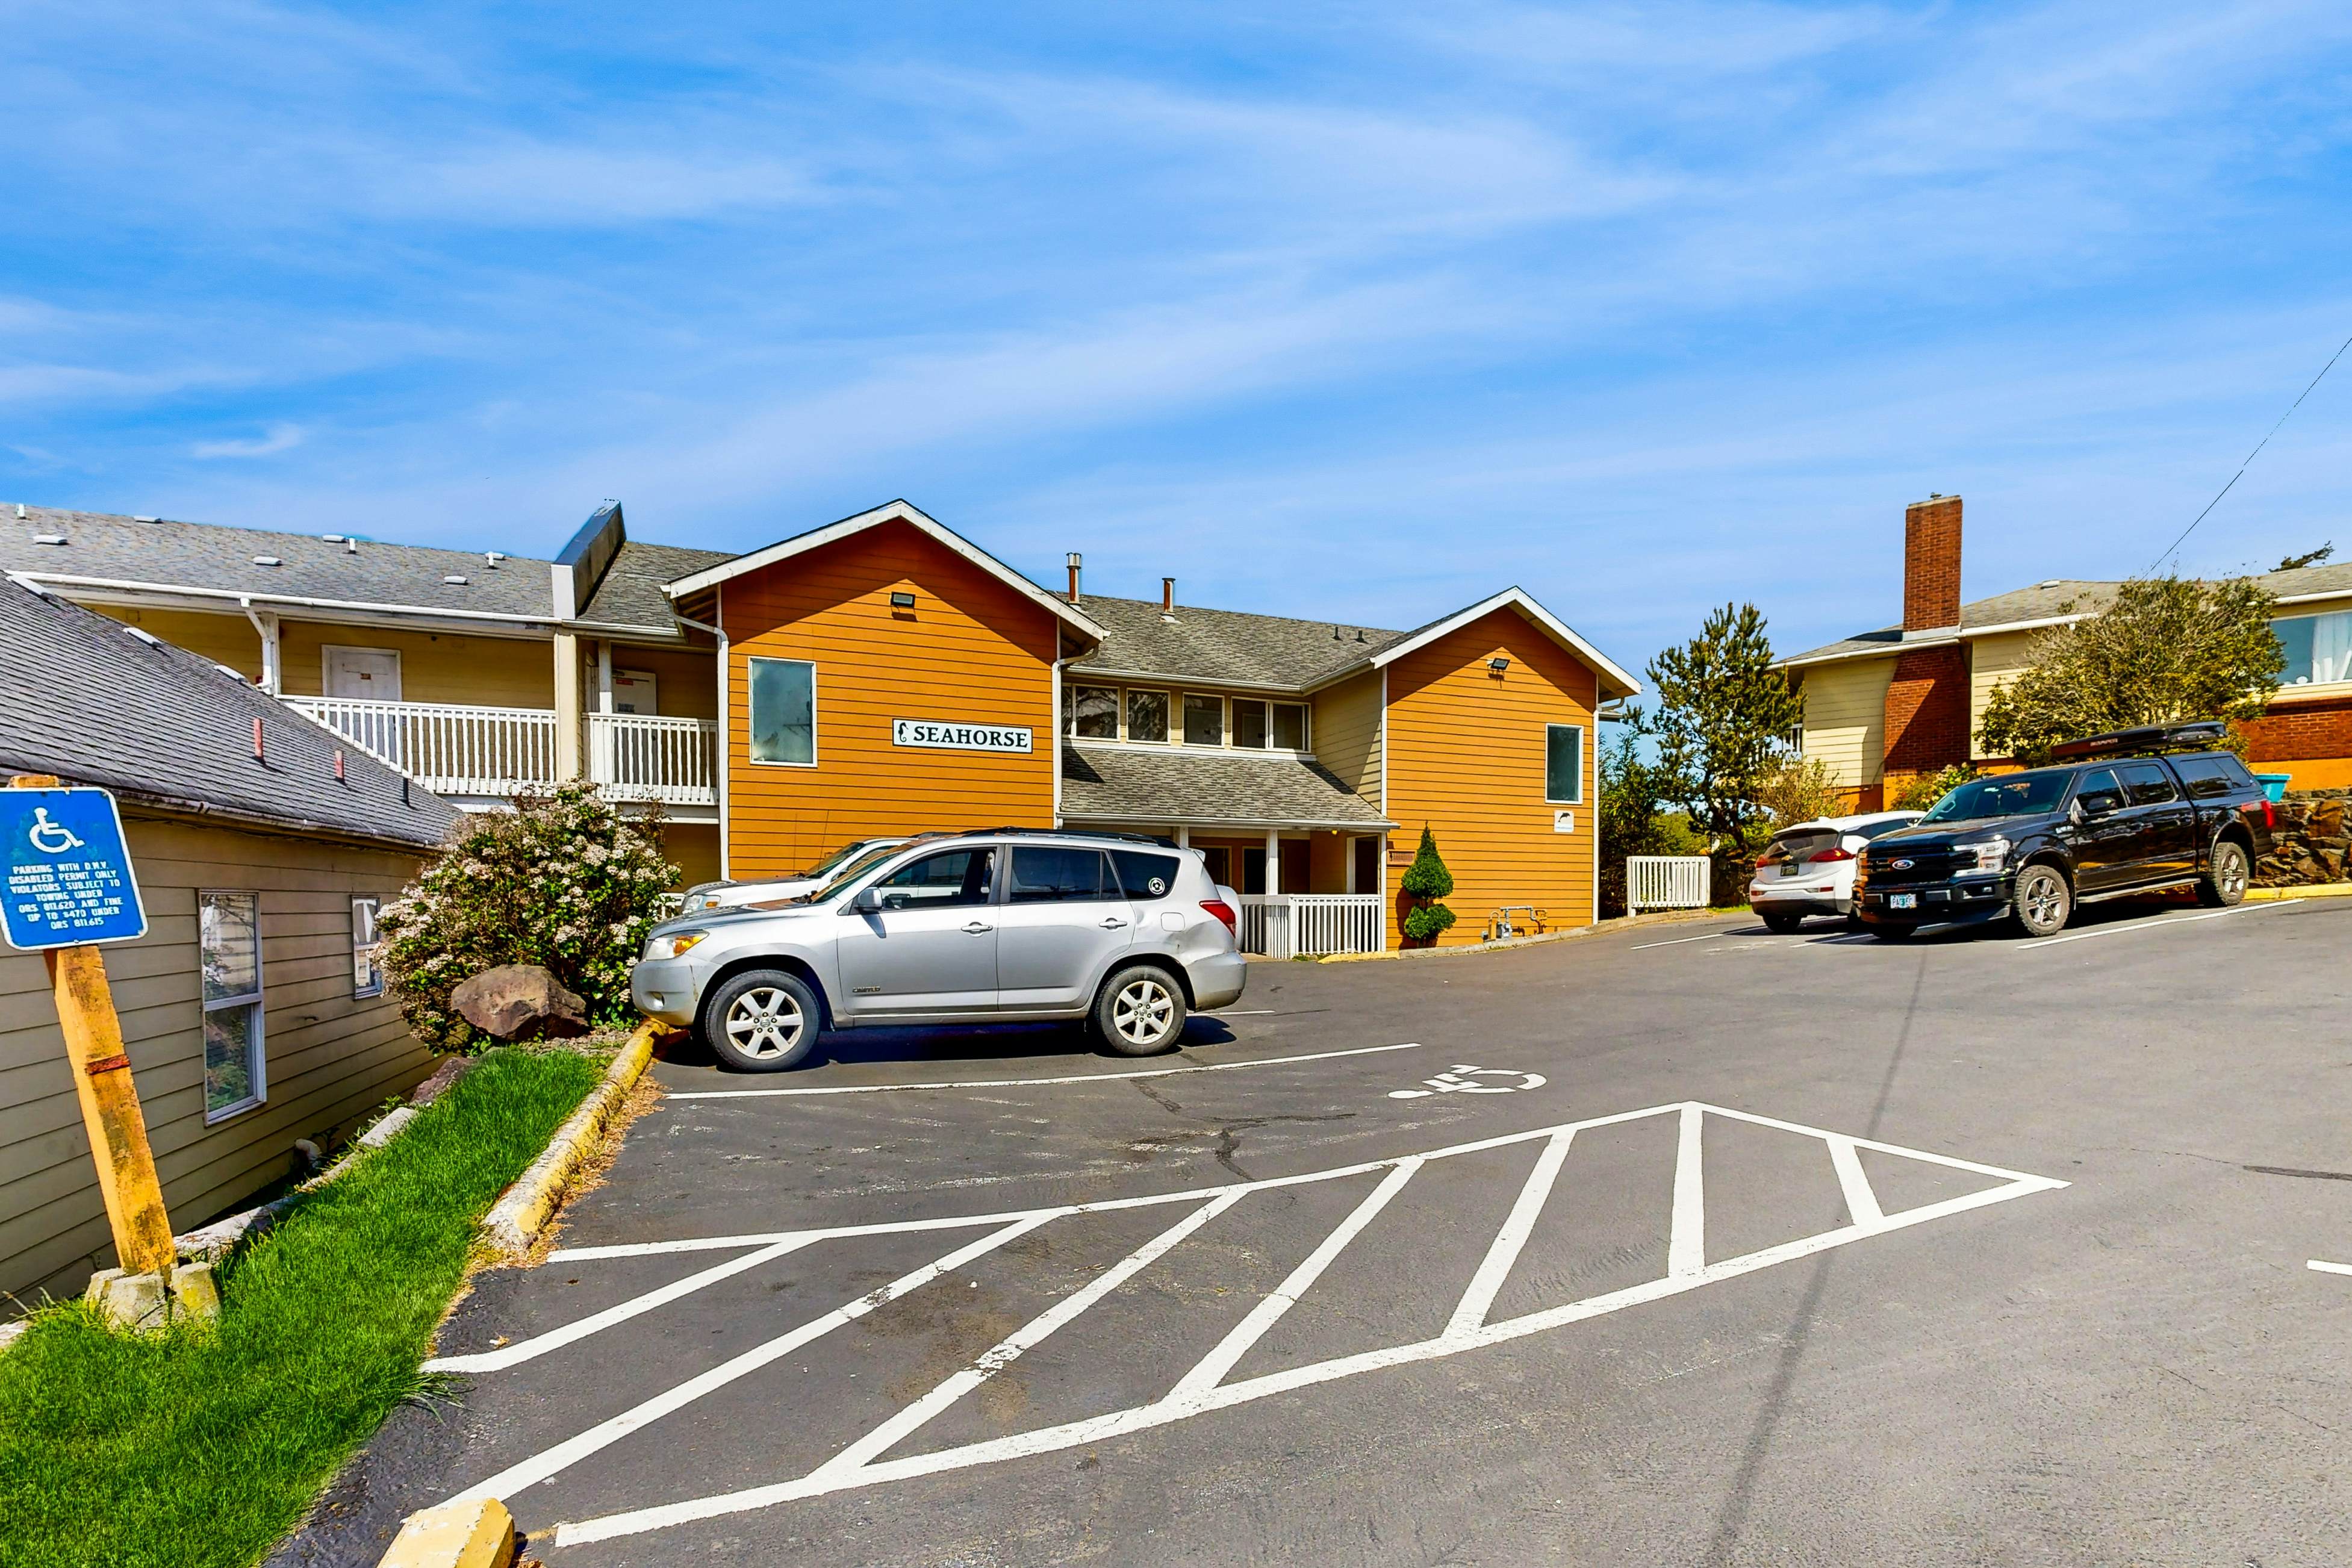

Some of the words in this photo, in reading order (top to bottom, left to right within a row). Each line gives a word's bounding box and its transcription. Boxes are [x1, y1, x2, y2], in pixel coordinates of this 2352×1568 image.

[913, 726, 1028, 748] SEAHORSE
[13, 865, 53, 874] PARKING
[57, 863, 79, 871] WITH
[84, 861, 109, 870] D.M.V.
[8, 874, 54, 885] DISABLED
[58, 871, 90, 881] PERMIT
[95, 870, 116, 879] ONLY
[10, 883, 61, 894] VIOLATORS
[66, 880, 104, 890] SUBJECT
[108, 879, 120, 887] TO
[35, 892, 70, 901] TOWING
[74, 889, 103, 899] UNDER
[19, 904, 39, 913] ORS
[81, 899, 99, 907] AND
[104, 897, 123, 906] FINE
[27, 913, 41, 922] UP
[46, 912, 58, 920] TO
[63, 909, 87, 918] $470
[91, 907, 120, 916] UNDER
[51, 920, 69, 930] ORS
[73, 917, 104, 927] 811.615
